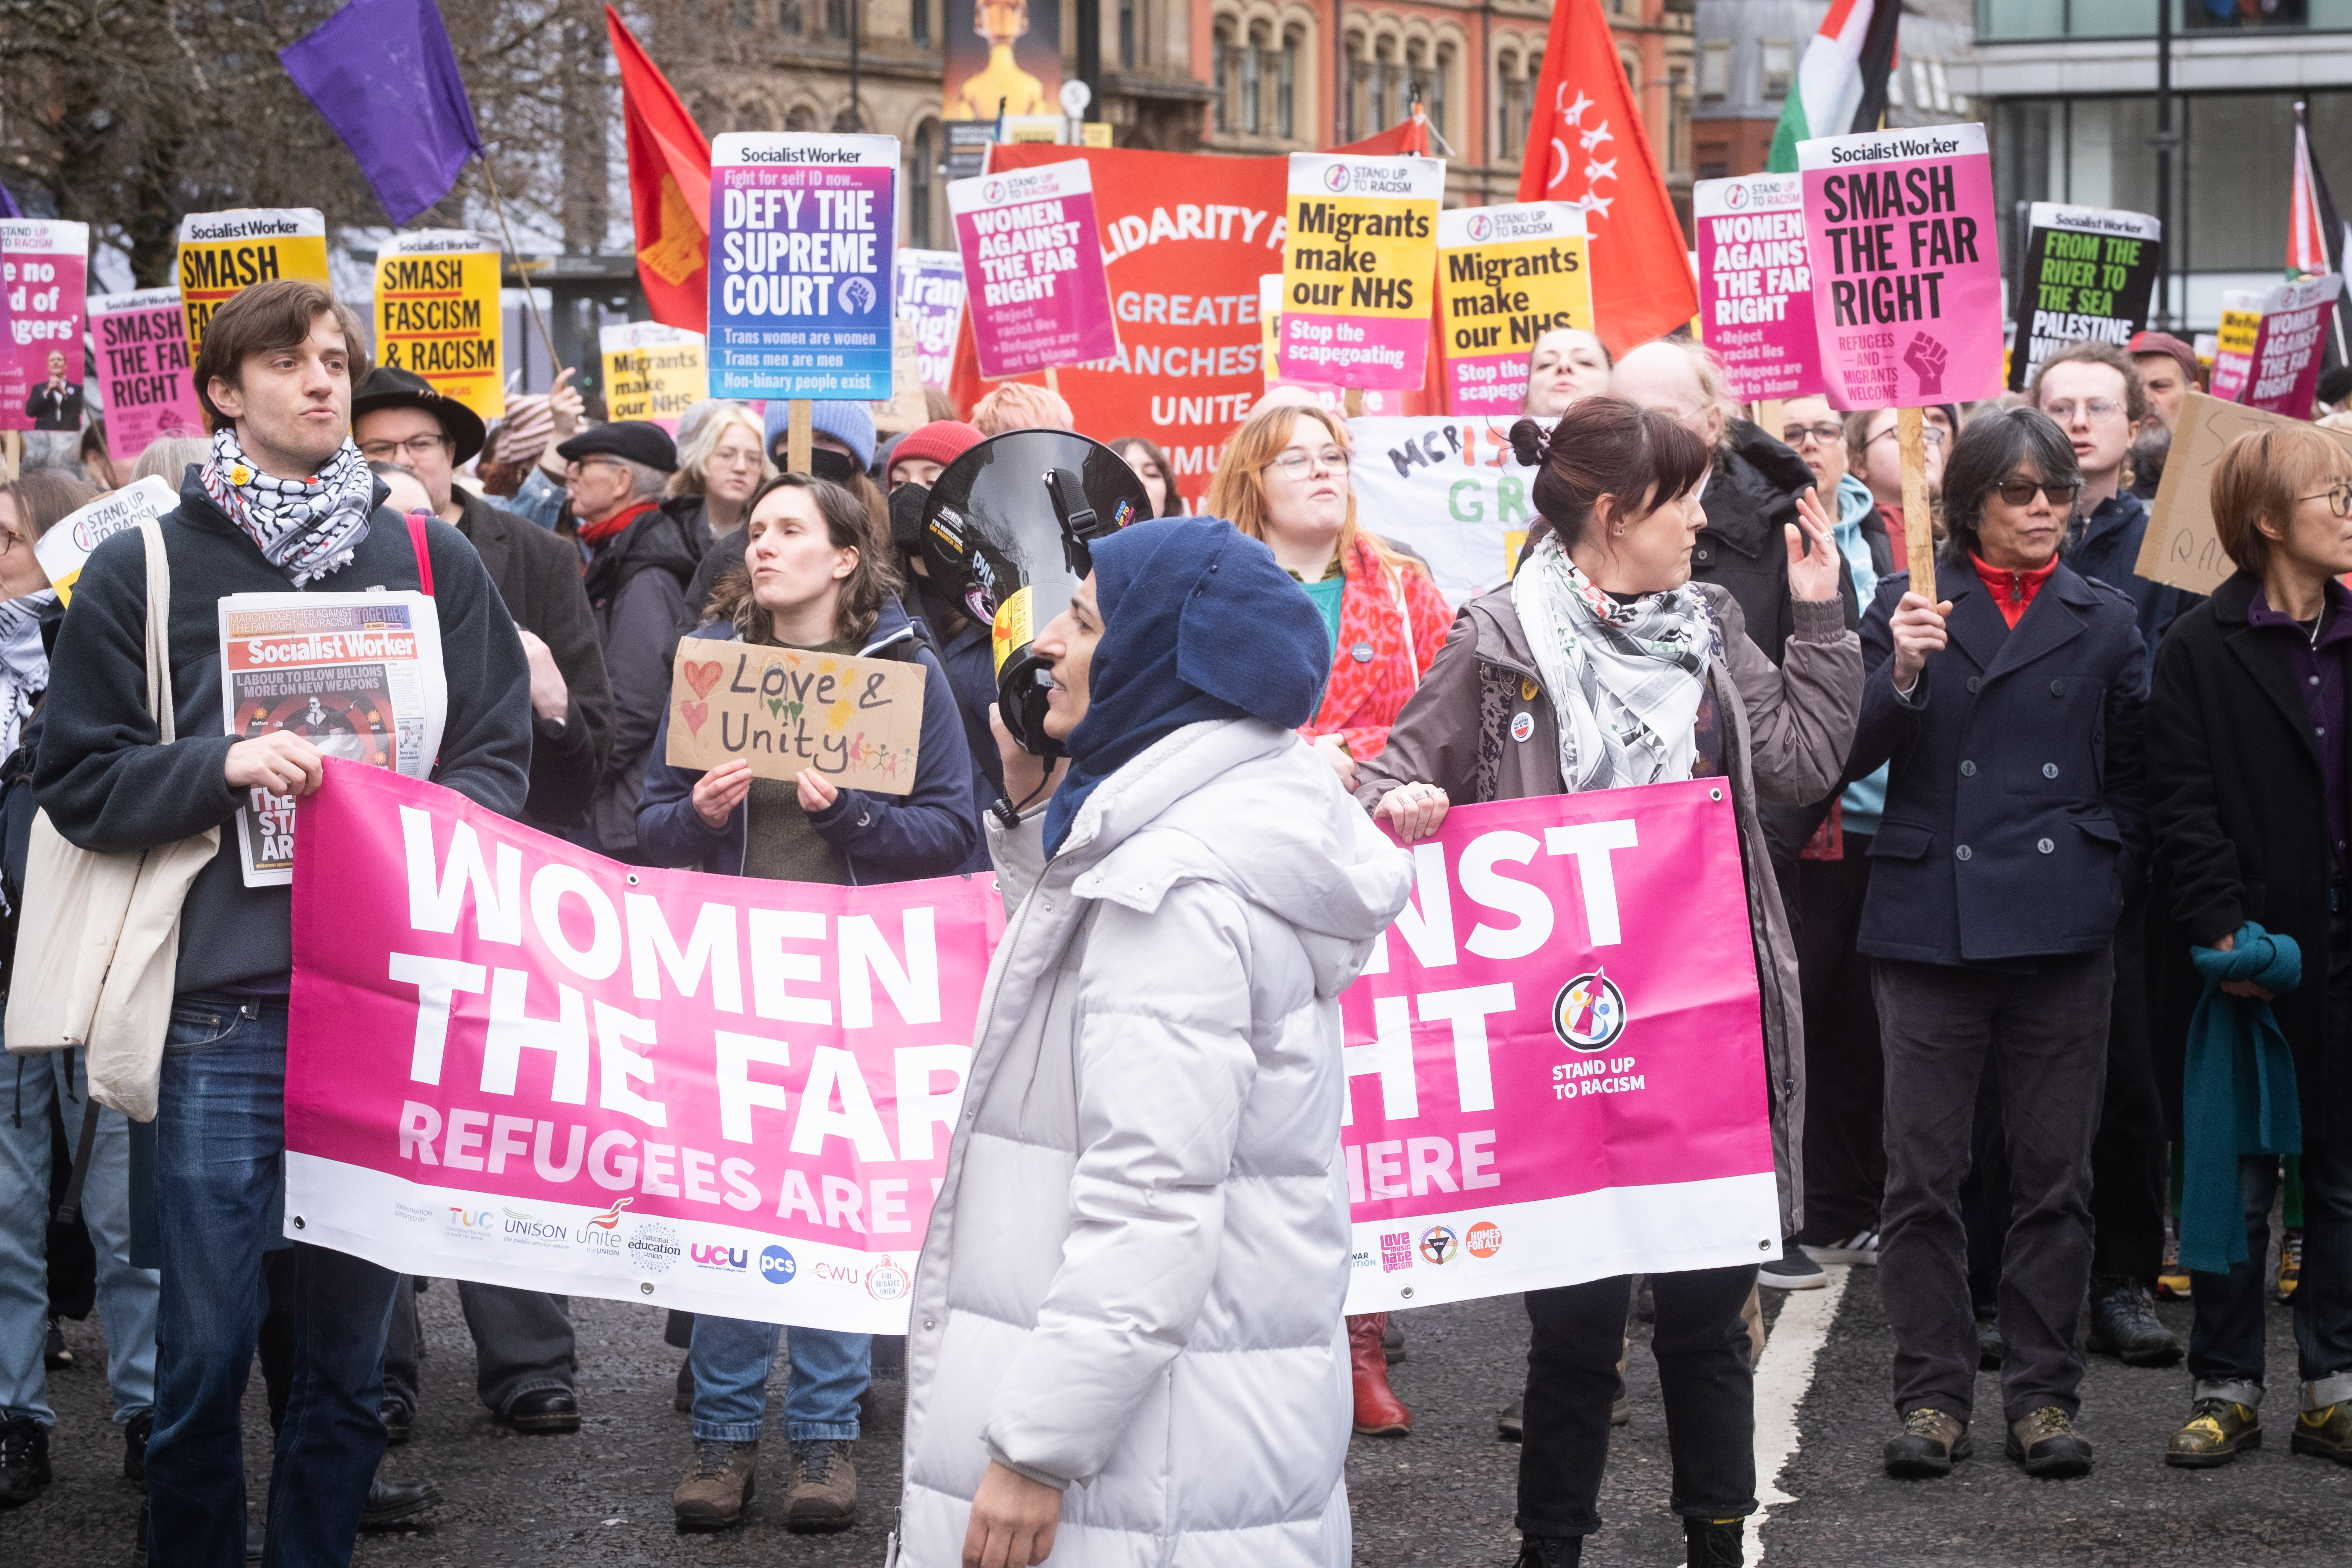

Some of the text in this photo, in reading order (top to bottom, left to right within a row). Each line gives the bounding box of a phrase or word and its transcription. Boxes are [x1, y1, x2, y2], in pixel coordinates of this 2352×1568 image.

[741, 147, 861, 163] Socialist Worker
[1831, 138, 1959, 164] Socialist Worker
[725, 171, 862, 188] Fight for self ID now...
[1355, 167, 1407, 179] STAND UP
[1355, 180, 1411, 193] TO RACISM
[1824, 165, 1955, 222] SMASH
[724, 189, 874, 230] DEFY THE
[973, 200, 1064, 236] WOMEN
[1298, 202, 1429, 242] Migrants
[192, 219, 298, 239] Socialist Worker
[979, 222, 1080, 259] AGAINST
[1496, 223, 1553, 237] TO RACISM
[1712, 213, 1803, 243] WOMEN
[723, 231, 877, 273] SUPREME
[1295, 242, 1376, 273] make
[1825, 217, 1979, 274] THE FAR
[2045, 231, 2142, 266] FROM THE
[183, 245, 279, 288] SMASH
[384, 260, 462, 289] SMASH
[980, 257, 1027, 283] THE
[1031, 247, 1077, 274] FAR
[1449, 247, 1578, 286] Migrants
[2040, 257, 2126, 291] RIVER TO
[723, 274, 834, 315] COURT
[984, 274, 1056, 307] RIGHT
[1293, 277, 1413, 309] our NHS
[1714, 266, 1810, 298] THE FAR
[1453, 288, 1529, 318] make
[1715, 295, 1788, 325] RIGHT
[1831, 272, 1944, 327] RIGHT
[2038, 284, 2113, 316] THE SEA
[103, 311, 183, 345] SMASH
[385, 299, 480, 330] FASCISM
[2032, 310, 2134, 346] PALESTINE
[2269, 307, 2319, 335] WOMEN
[725, 328, 876, 345] Trans women are women
[1290, 320, 1364, 344] Stop the
[1839, 333, 1895, 351] REFUGEES
[2263, 325, 2321, 357] AGAINST
[386, 340, 494, 370] & RACISM
[614, 352, 698, 374] Migrants
[725, 350, 843, 367] Trans men are men
[1288, 345, 1404, 369] scapegoating
[2261, 348, 2311, 378] THE FAR
[616, 369, 665, 395] make
[725, 373, 870, 391] Non-binary people exist
[1457, 360, 1527, 382] Stop the
[1843, 367, 1898, 384] MIGRANTS
[112, 374, 178, 407] RIGHT
[1848, 385, 1898, 401] WELCOME
[2253, 373, 2298, 399] RIGHT
[1152, 393, 1252, 425] UNITE
[1387, 425, 1508, 478] MCR IS
[88, 492, 144, 529] STAND UP
[1115, 500, 1126, 522] STAND
[1118, 506, 1129, 526] UP TO
[230, 608, 352, 623] MARCH TOGETHER AGAINST
[230, 617, 352, 632] THE FAR RIGHT AND RACISM
[1013, 590, 1026, 646] SMASH THE NAZIS
[248, 633, 414, 664] Socialist Worker
[236, 666, 383, 687] LABOUR TO BLOW BILLIONS
[244, 678, 379, 698] MORE ON NEW WEAPONS
[731, 654, 892, 709] Love &
[1513, 718, 1528, 726] PALESTINE
[722, 711, 847, 773] Unity
[399, 805, 940, 1029] WOMEN
[389, 952, 973, 1162] THE FAR
[1552, 1057, 1635, 1081] STAND UP
[1553, 1075, 1645, 1100] TO RACISM
[399, 1100, 911, 1234] REFUGEES ARE
[394, 1210, 417, 1222] SUPPORTED
[395, 1202, 432, 1216] DEMONSTRATION
[448, 1207, 494, 1229] TUC
[505, 1220, 566, 1239] UNISON
[643, 1235, 668, 1244] national
[1418, 1225, 1456, 1241] Disabled People
[1471, 1228, 1500, 1241] HOMES
[628, 1240, 681, 1256] education
[1382, 1251, 1412, 1264] hate
[1467, 1238, 1501, 1251] FOR ALL
[761, 1256, 794, 1273] pcs
[816, 1263, 857, 1284] CWU
